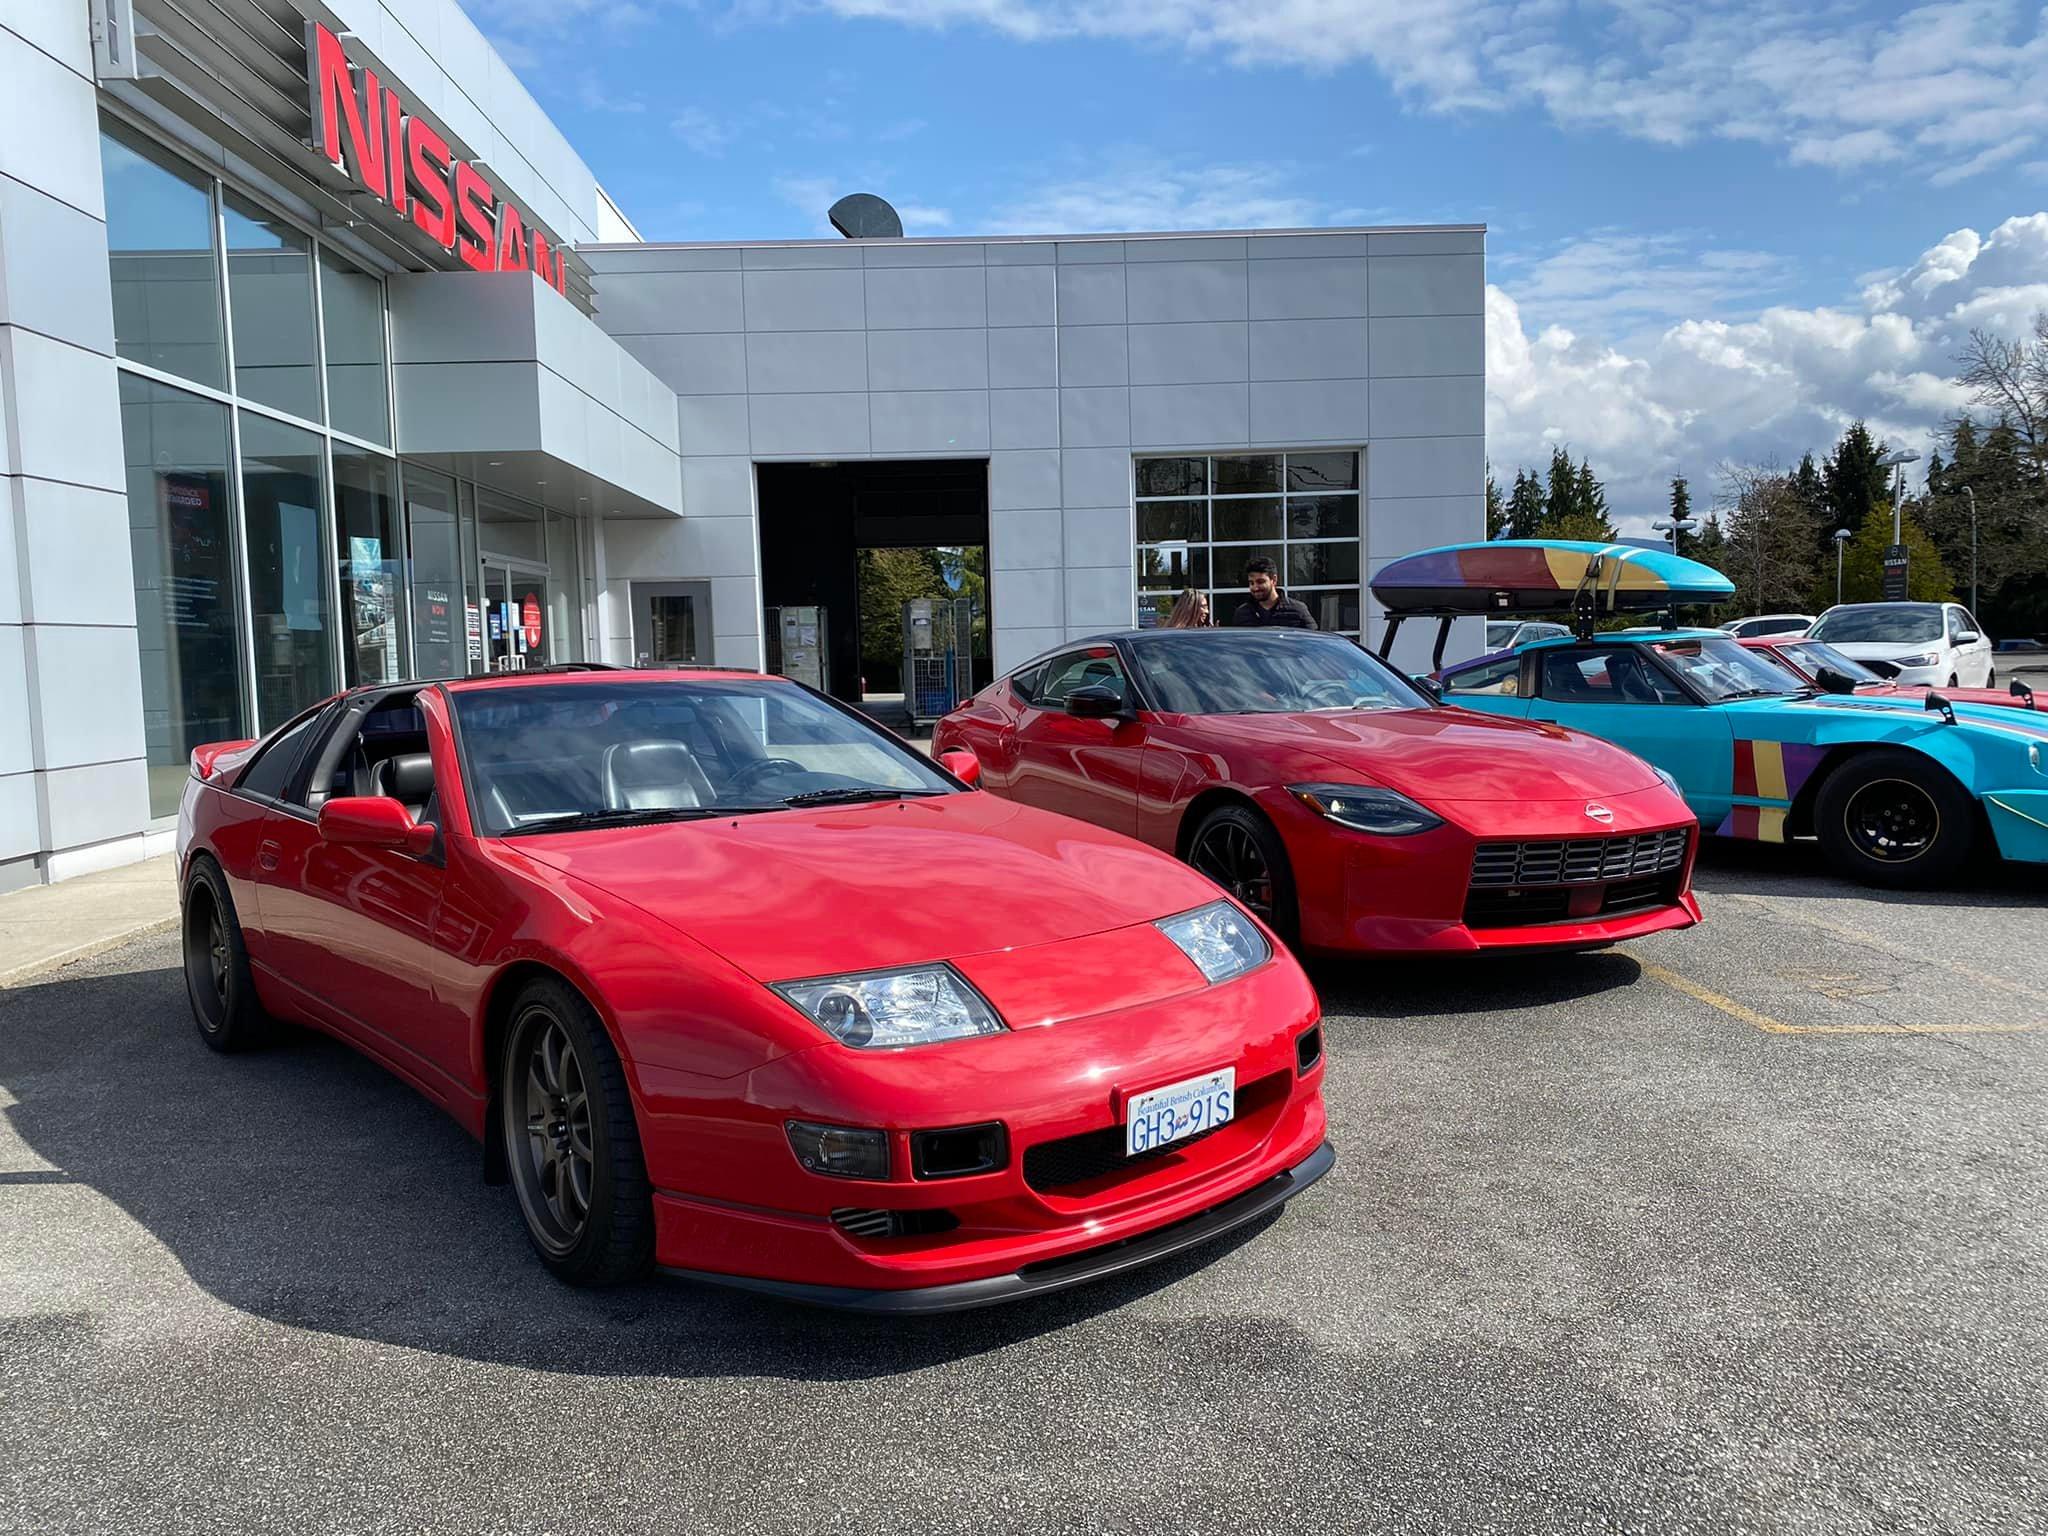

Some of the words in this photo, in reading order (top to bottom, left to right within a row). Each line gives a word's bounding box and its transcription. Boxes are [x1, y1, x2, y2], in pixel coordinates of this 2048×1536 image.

[306, 20, 566, 297] NISSAN
[427, 590, 449, 604] NISSAN
[1132, 1108, 1175, 1153] GH3
[1190, 1091, 1231, 1135] 91S
[1137, 1097, 1169, 1117] Beautiful
[1170, 1091, 1194, 1107] British
[1193, 1082, 1226, 1099] Columbia
